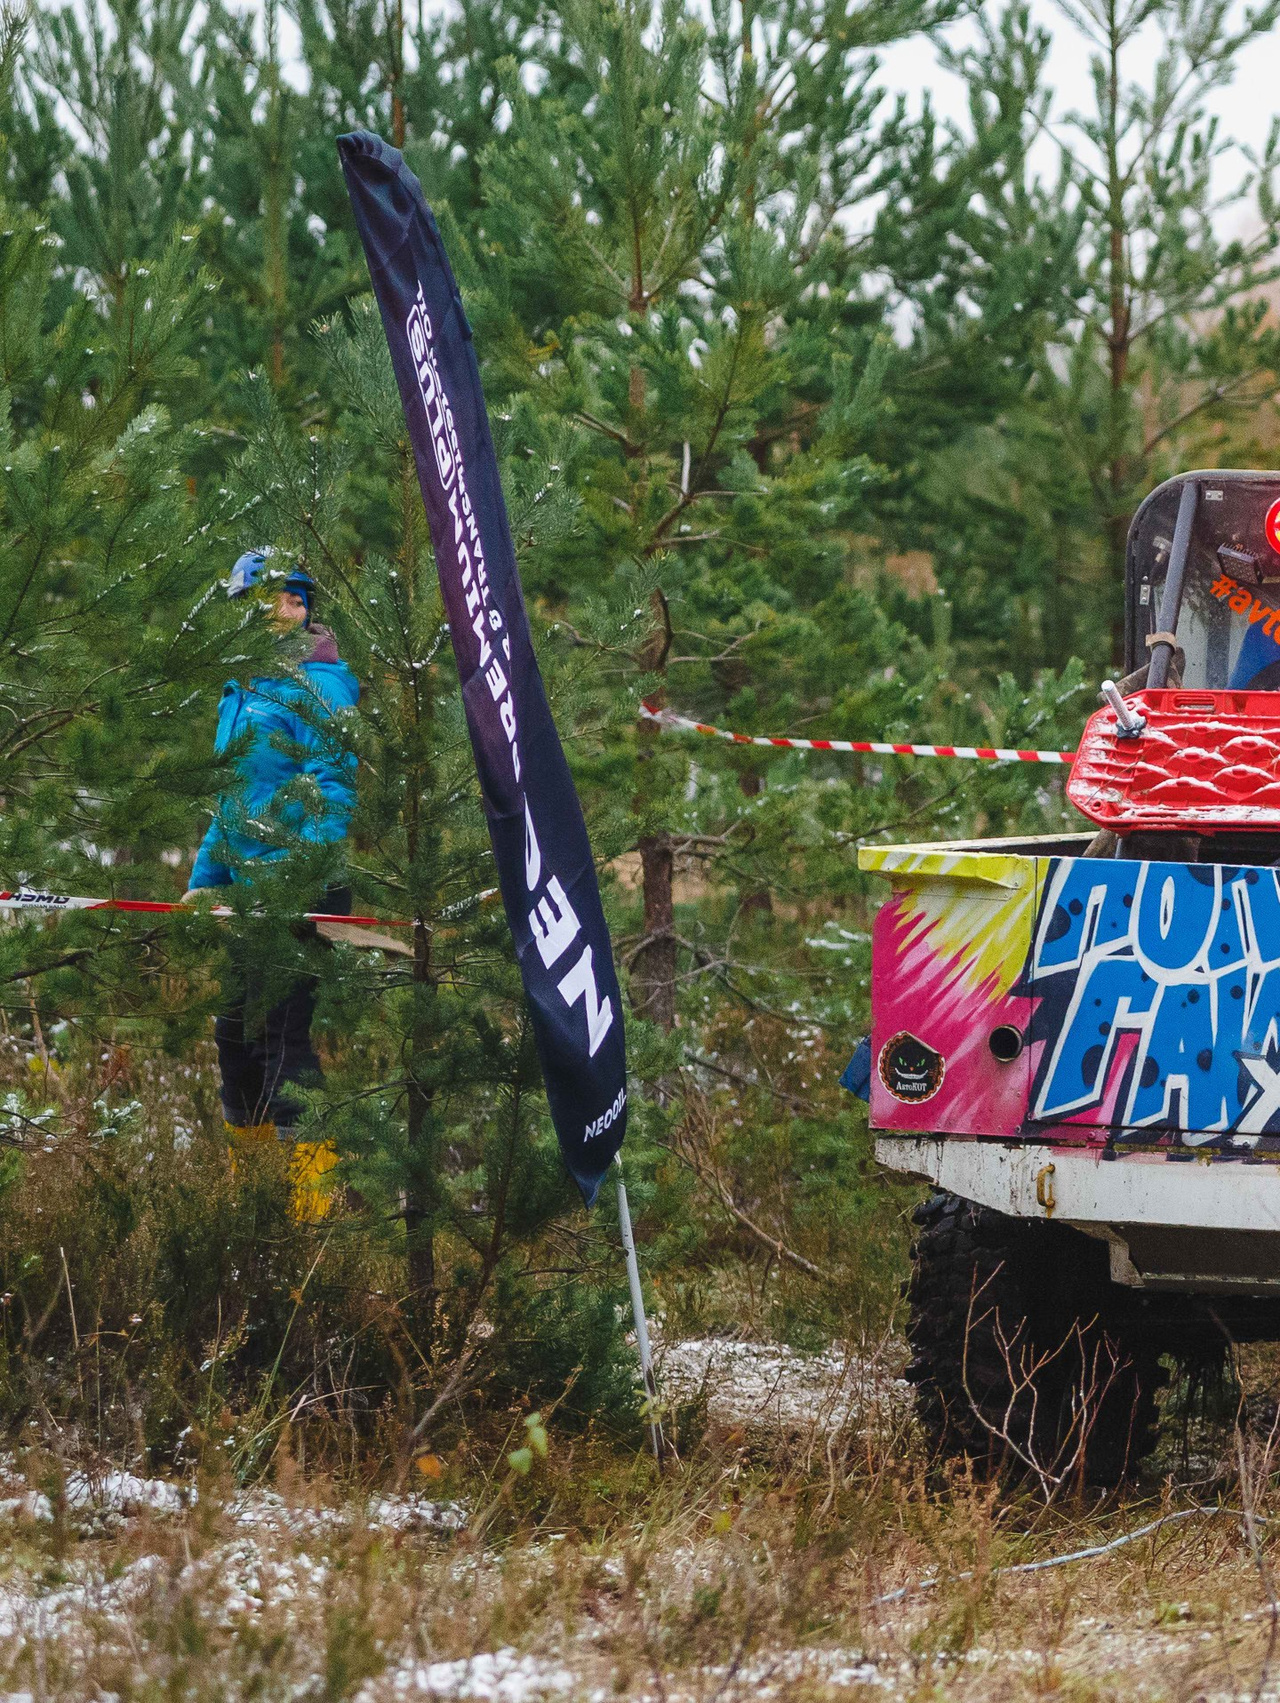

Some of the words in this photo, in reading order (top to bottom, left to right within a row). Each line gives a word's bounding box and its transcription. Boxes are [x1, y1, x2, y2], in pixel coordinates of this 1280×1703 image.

[411, 319, 453, 479] PLUS
[429, 347, 490, 607] TRANSMISSI
[583, 1087, 627, 1143] NEOOIL
